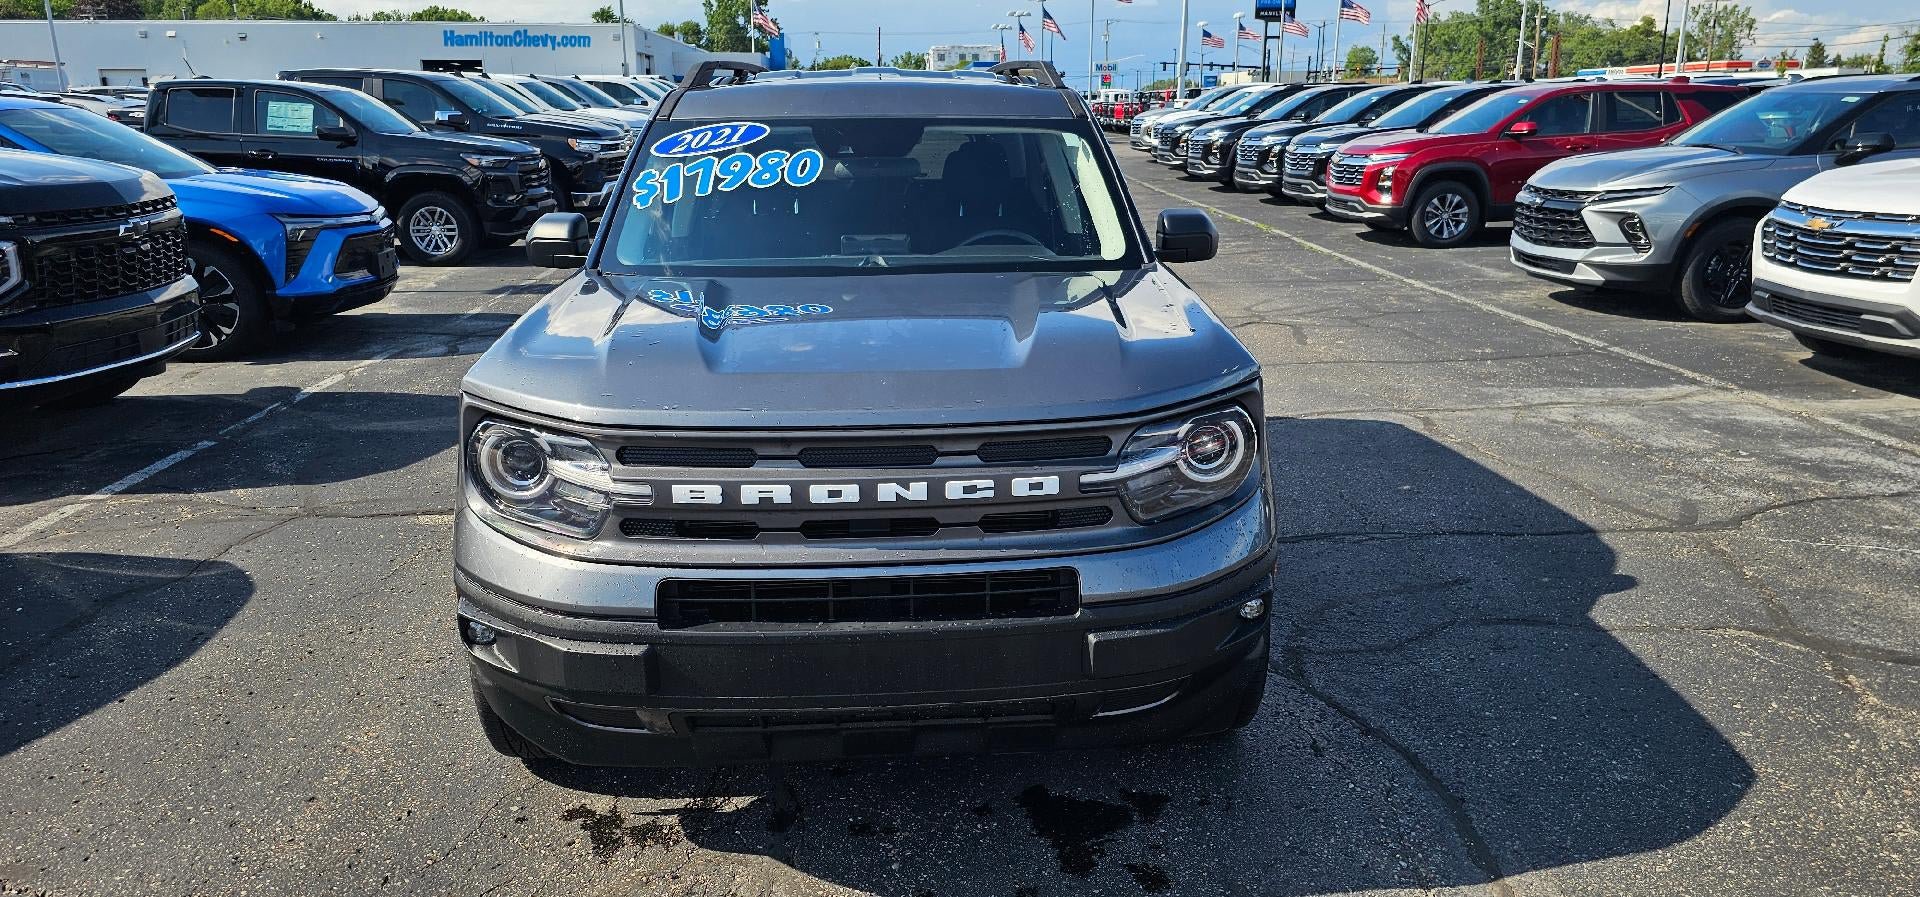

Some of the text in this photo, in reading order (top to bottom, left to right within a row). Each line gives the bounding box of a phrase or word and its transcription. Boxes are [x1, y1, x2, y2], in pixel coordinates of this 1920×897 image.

[443, 29, 591, 50] HamiltonChevy.com
[1095, 63, 1117, 71] Mobil
[669, 123, 749, 154] 2021
[632, 148, 824, 210] $17980
[671, 475, 1060, 505] BRONCO
